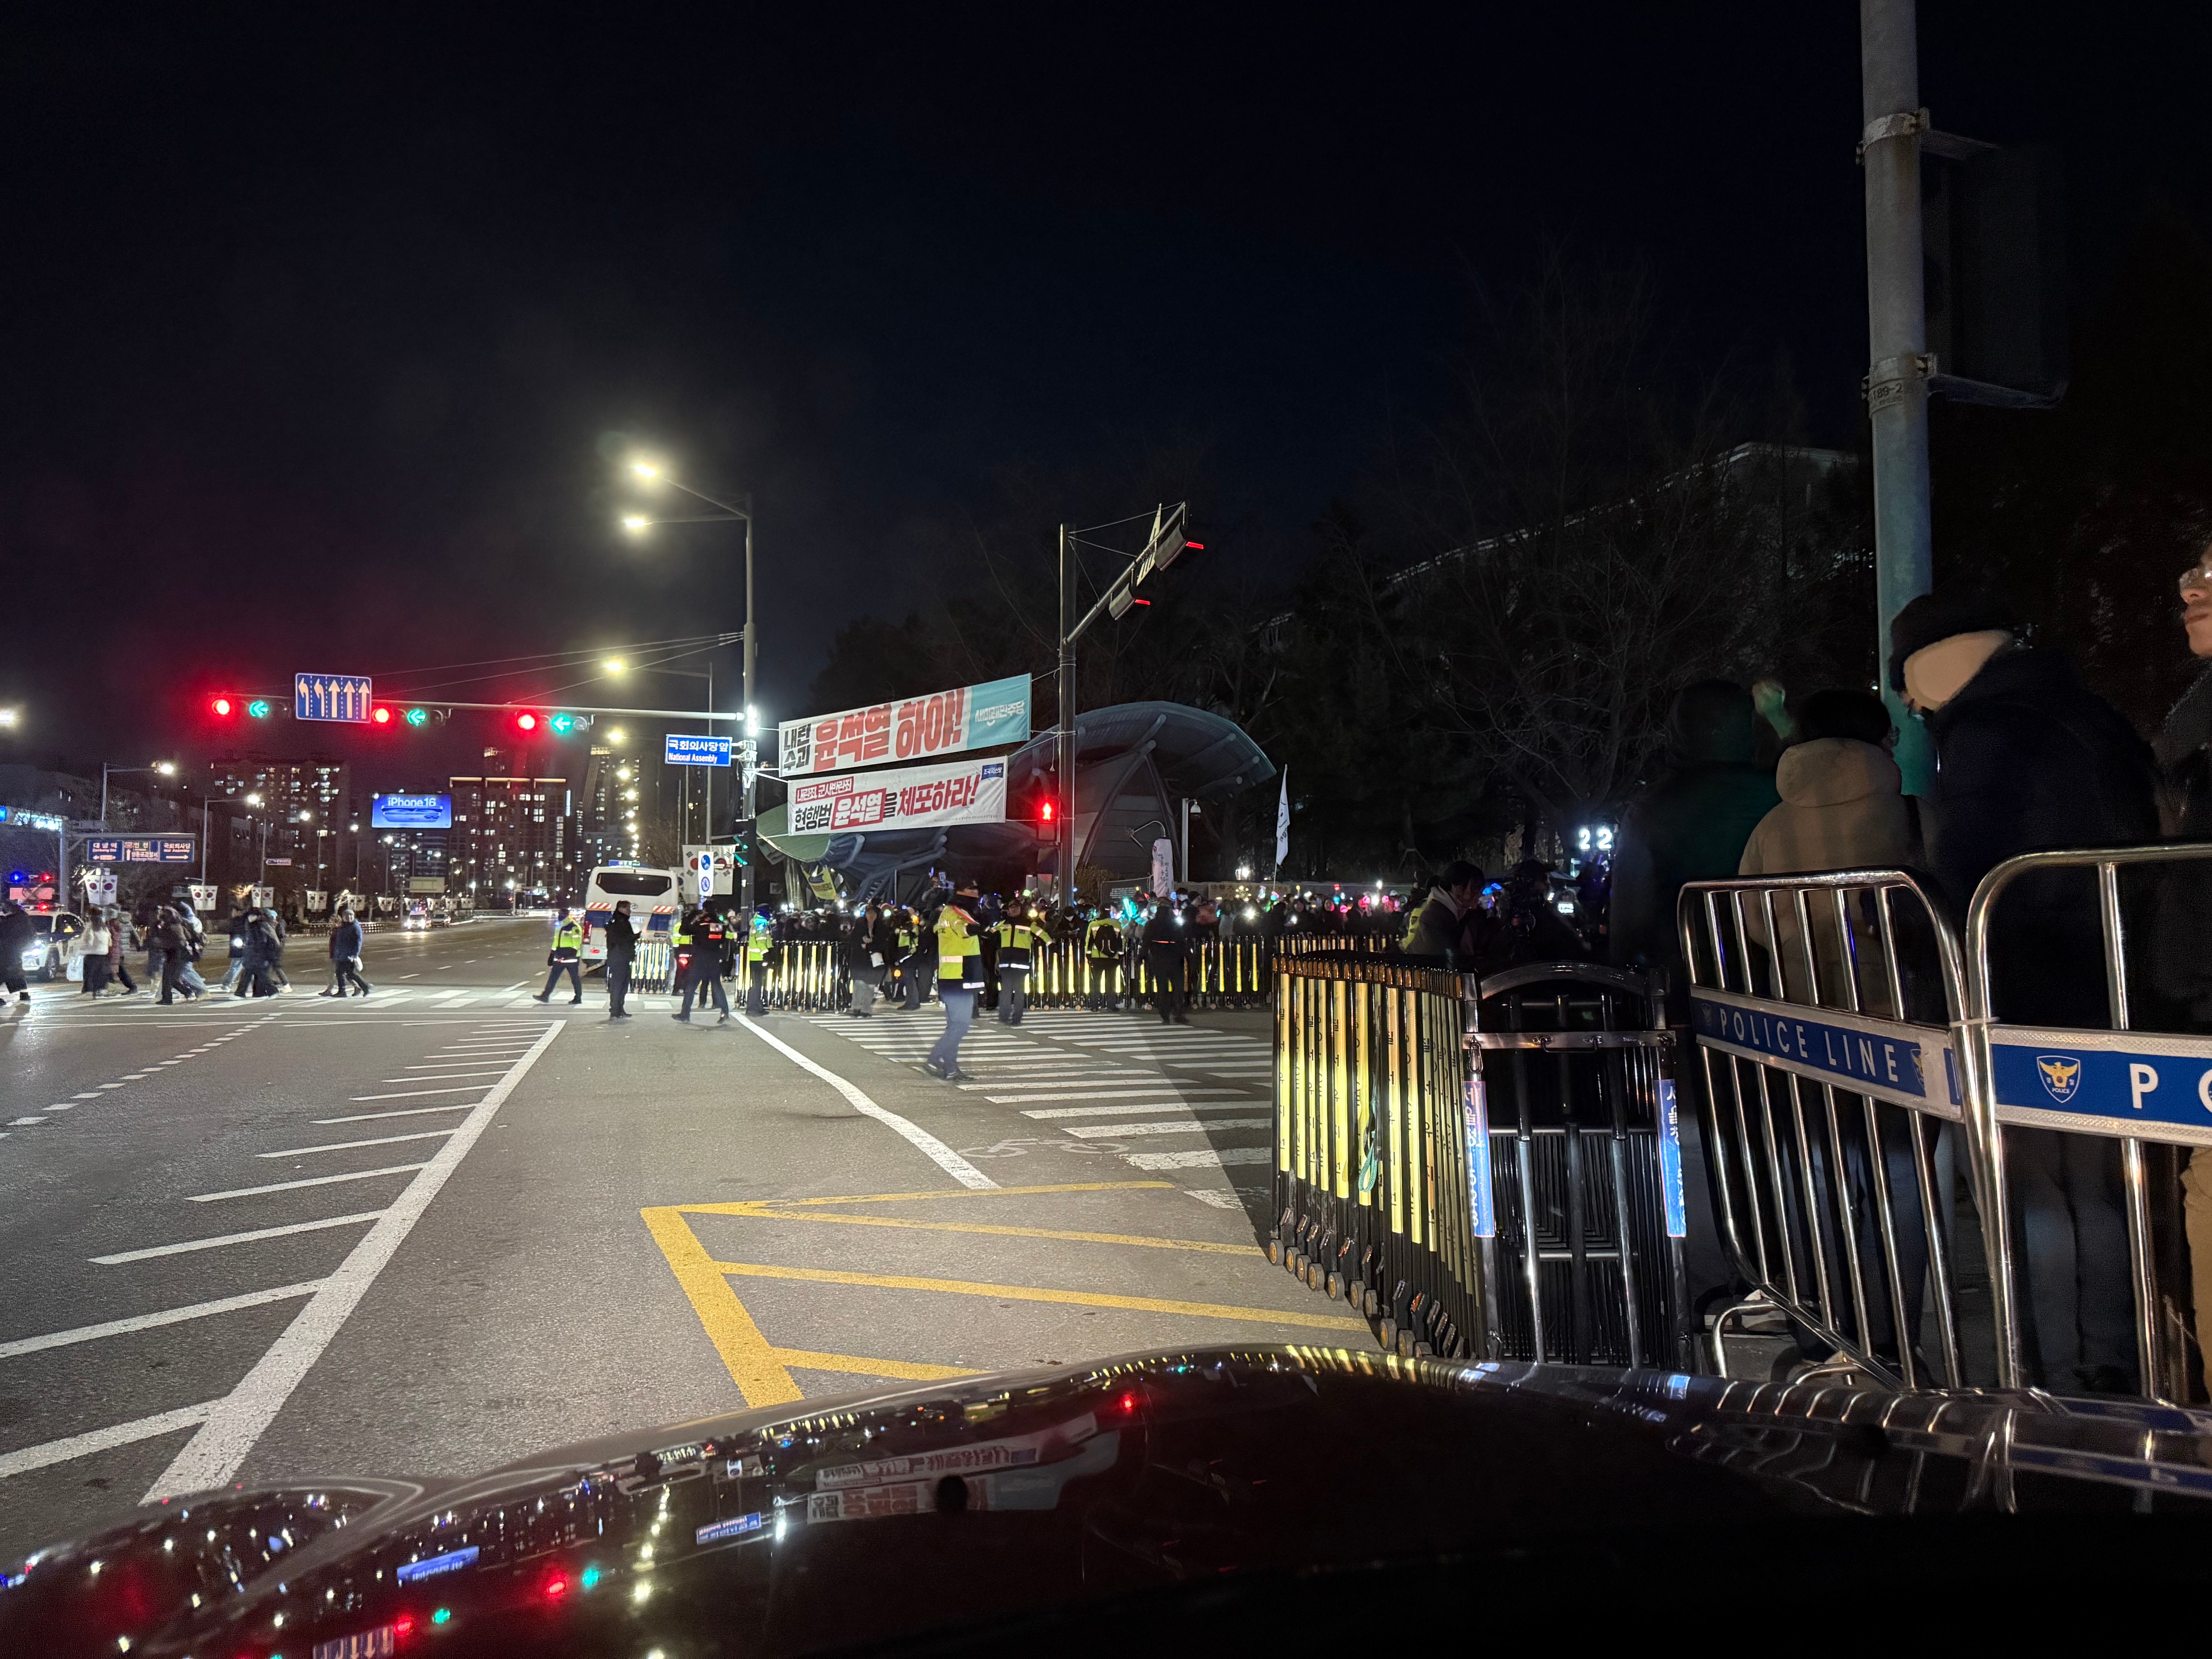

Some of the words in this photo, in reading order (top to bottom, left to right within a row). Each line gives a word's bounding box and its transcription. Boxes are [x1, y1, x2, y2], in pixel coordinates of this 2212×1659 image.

[975, 700, 1025, 724] 새미래민주당
[784, 723, 811, 751] 내란
[814, 703, 892, 772] 윤석열
[896, 688, 965, 758] 하야!
[668, 740, 729, 752] 국회의사당앞
[668, 753, 690, 761] National
[692, 754, 718, 764] Assembly
[784, 744, 811, 771] 수괴
[818, 778, 852, 798] 군사반란죄
[388, 797, 423, 807] iPhone
[424, 797, 436, 807] 16
[795, 803, 833, 832] 현행범
[897, 774, 981, 816] 체포하라!
[1720, 1008, 1808, 1058] POLICE
[1825, 1030, 1899, 1082] LINE
